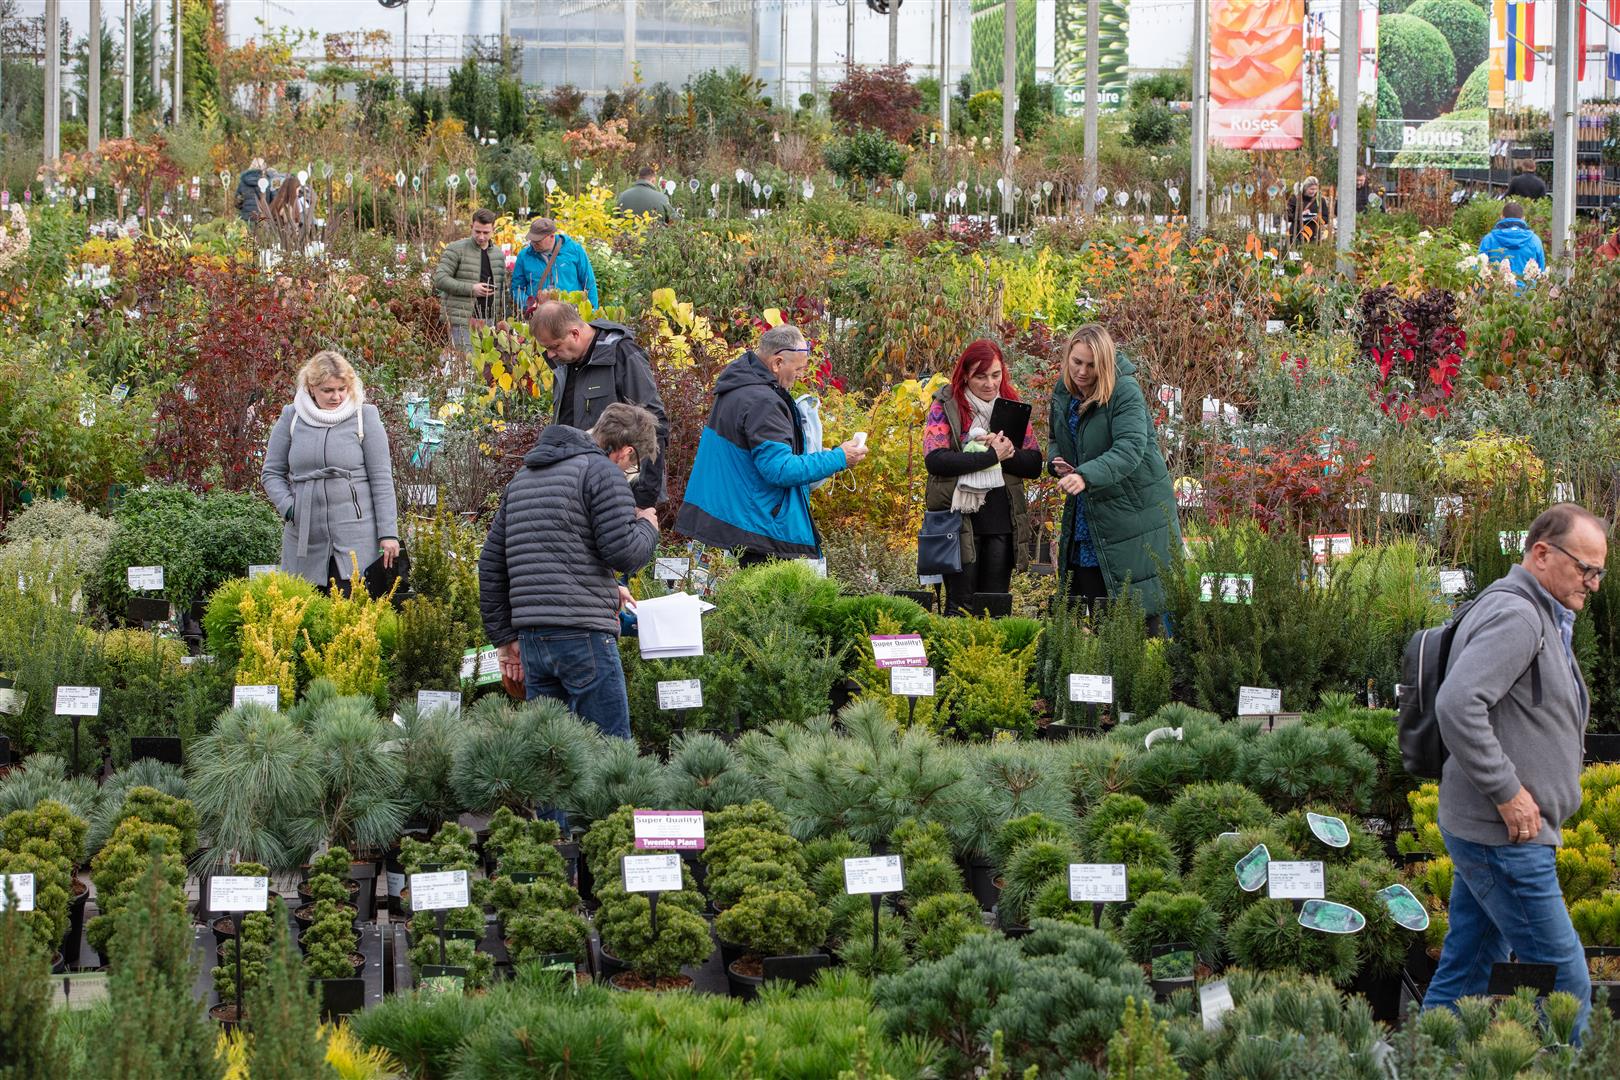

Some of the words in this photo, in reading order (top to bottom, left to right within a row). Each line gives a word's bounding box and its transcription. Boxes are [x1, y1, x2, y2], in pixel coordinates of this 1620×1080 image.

[1064, 89, 1119, 103] Solaire
[1231, 115, 1279, 131] Roses
[1403, 126, 1464, 146] Buxus
[894, 639, 922, 647] Quality!
[636, 816, 662, 824] Super
[665, 816, 702, 824] Quality!
[643, 838, 676, 846] Twenthe
[677, 838, 697, 846] Plant
